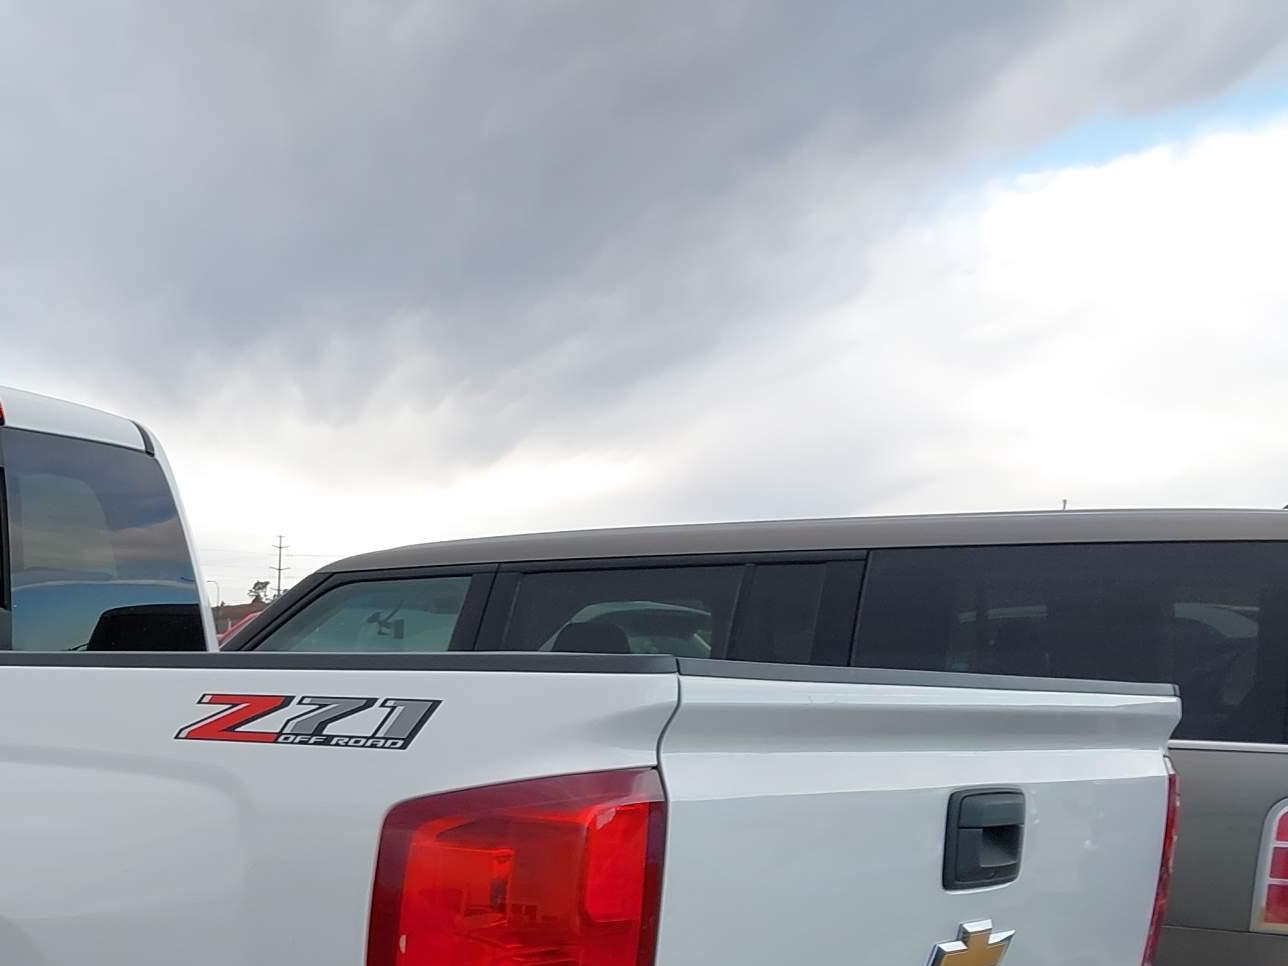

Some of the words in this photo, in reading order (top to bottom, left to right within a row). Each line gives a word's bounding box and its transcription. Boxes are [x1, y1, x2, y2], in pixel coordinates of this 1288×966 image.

[174, 693, 443, 750] Z71
[276, 734, 324, 745] OFF
[330, 737, 404, 748] ROAD
